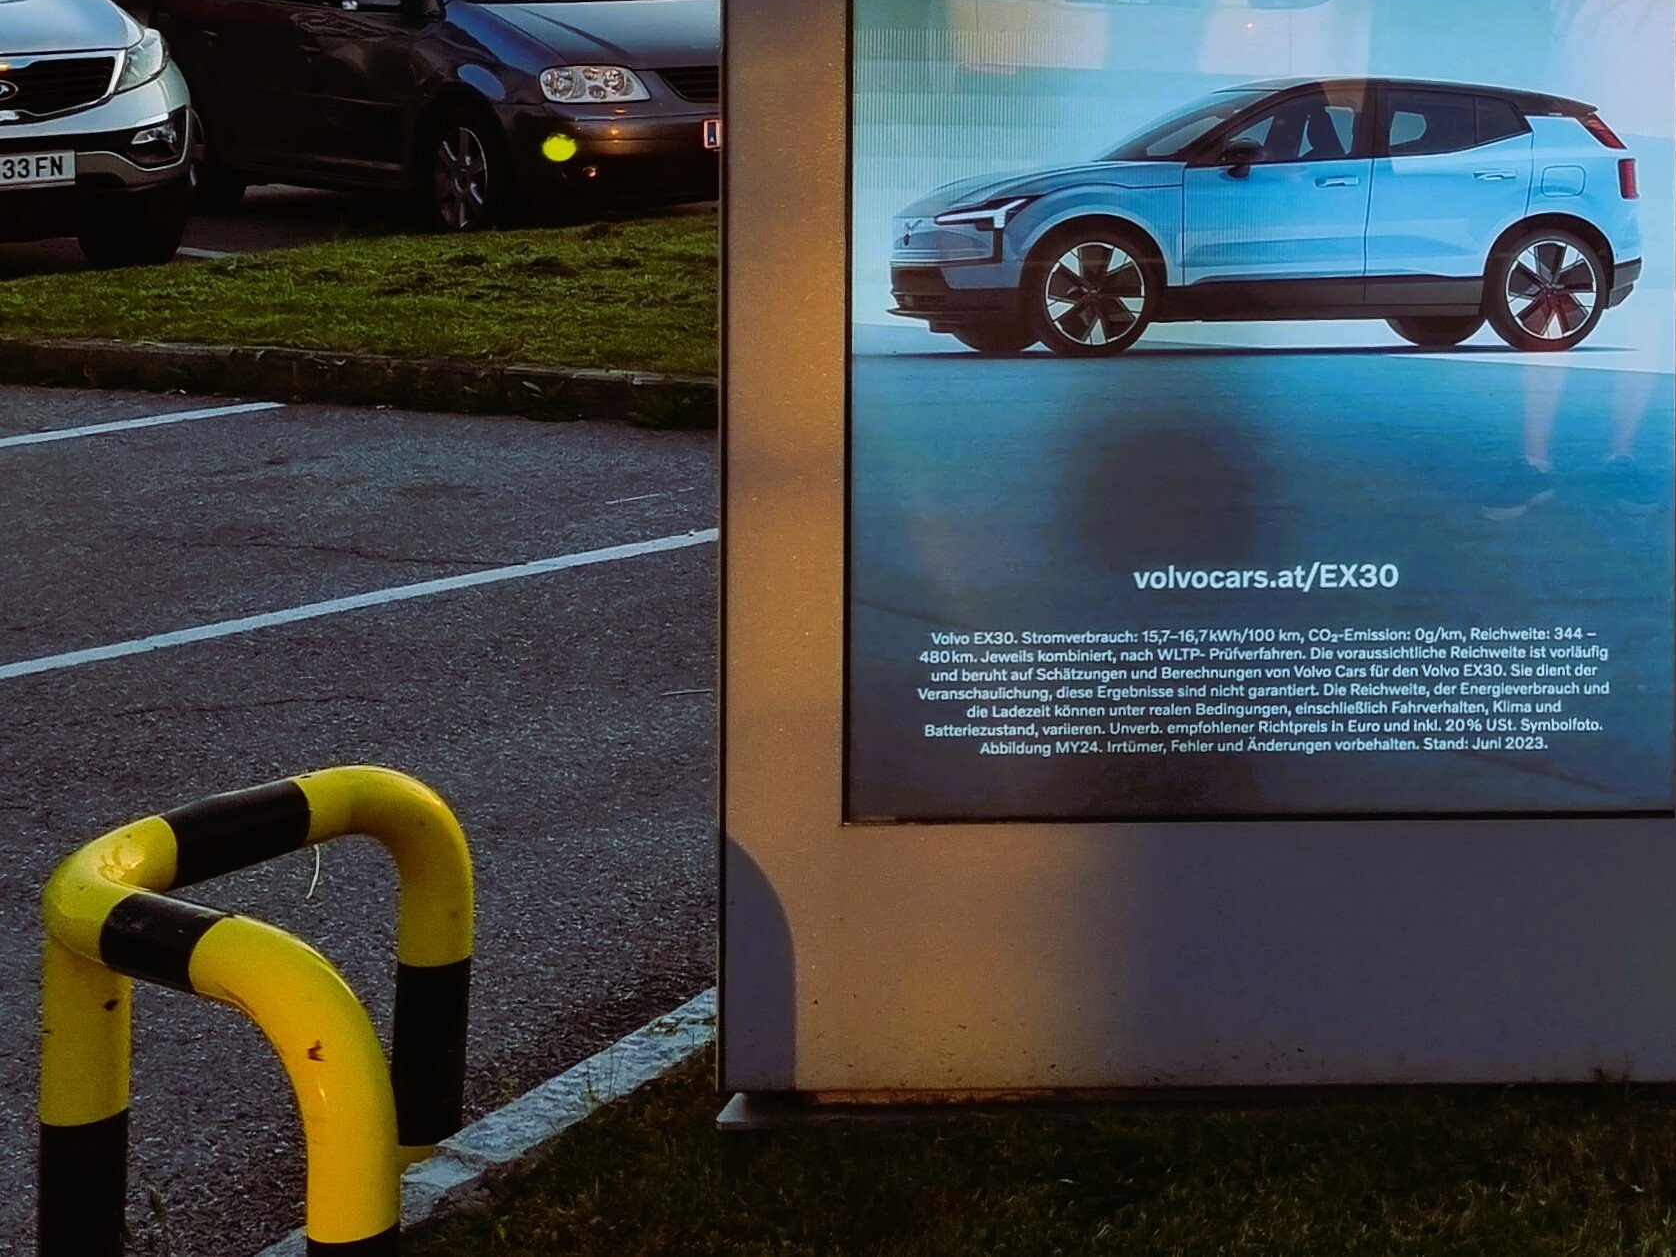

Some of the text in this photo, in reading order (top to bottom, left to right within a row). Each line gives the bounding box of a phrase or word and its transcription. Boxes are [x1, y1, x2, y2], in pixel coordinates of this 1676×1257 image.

[1132, 561, 1399, 593] volvocars.at/EX30
[931, 631, 970, 645] Volvo
[973, 631, 1018, 645] EX30.
[1021, 630, 1139, 645] Stromverbrauch:
[1279, 629, 1304, 644] km,
[1470, 626, 1550, 644] Reichweite:
[1554, 627, 1583, 640] 344
[980, 649, 1035, 664] Jeweils
[1038, 649, 1117, 665] kombiniert,
[1120, 648, 1153, 661] nach
[1209, 647, 1306, 664] Prüfverfahren.
[1310, 646, 1334, 659] Die
[1336, 645, 1447, 664] voraussichtliche
[1450, 644, 1526, 661] Reichweite
[1530, 645, 1546, 658] ist
[1549, 645, 1608, 661] vorläufig
[931, 663, 1598, 684] und beruht auf Schätzungen und Berechnungen von Volvo Cars für den Volvo EX30. Sie dient der
[917, 680, 1610, 703] Veranschaulichung, diese Ergebnisse sind nicht garantiert. Die Reichweite, der Energieverbrauch und
[967, 700, 1562, 720] die Ladezeit können unter realen Bedingungen, einschließlich Fahrverhalten, Klima und
[925, 722, 1039, 739] Batteriezustand,
[1042, 723, 1105, 735] variieren.
[1110, 722, 1165, 735] Unverb.
[1167, 719, 1256, 738] empfohlener
[1259, 719, 1330, 736] Richtpreis
[1331, 720, 1344, 732] in
[1347, 718, 1380, 733] Euro
[1384, 719, 1410, 732] und
[1413, 718, 1442, 732] inkl.
[1486, 717, 1517, 732] USt.
[1520, 717, 1603, 734] Symbolfoto.
[980, 736, 1548, 757] Abbildung MY24. Irrtümer, Fehler und Änderungen vorbehalten. Stand: Juni 2023.
